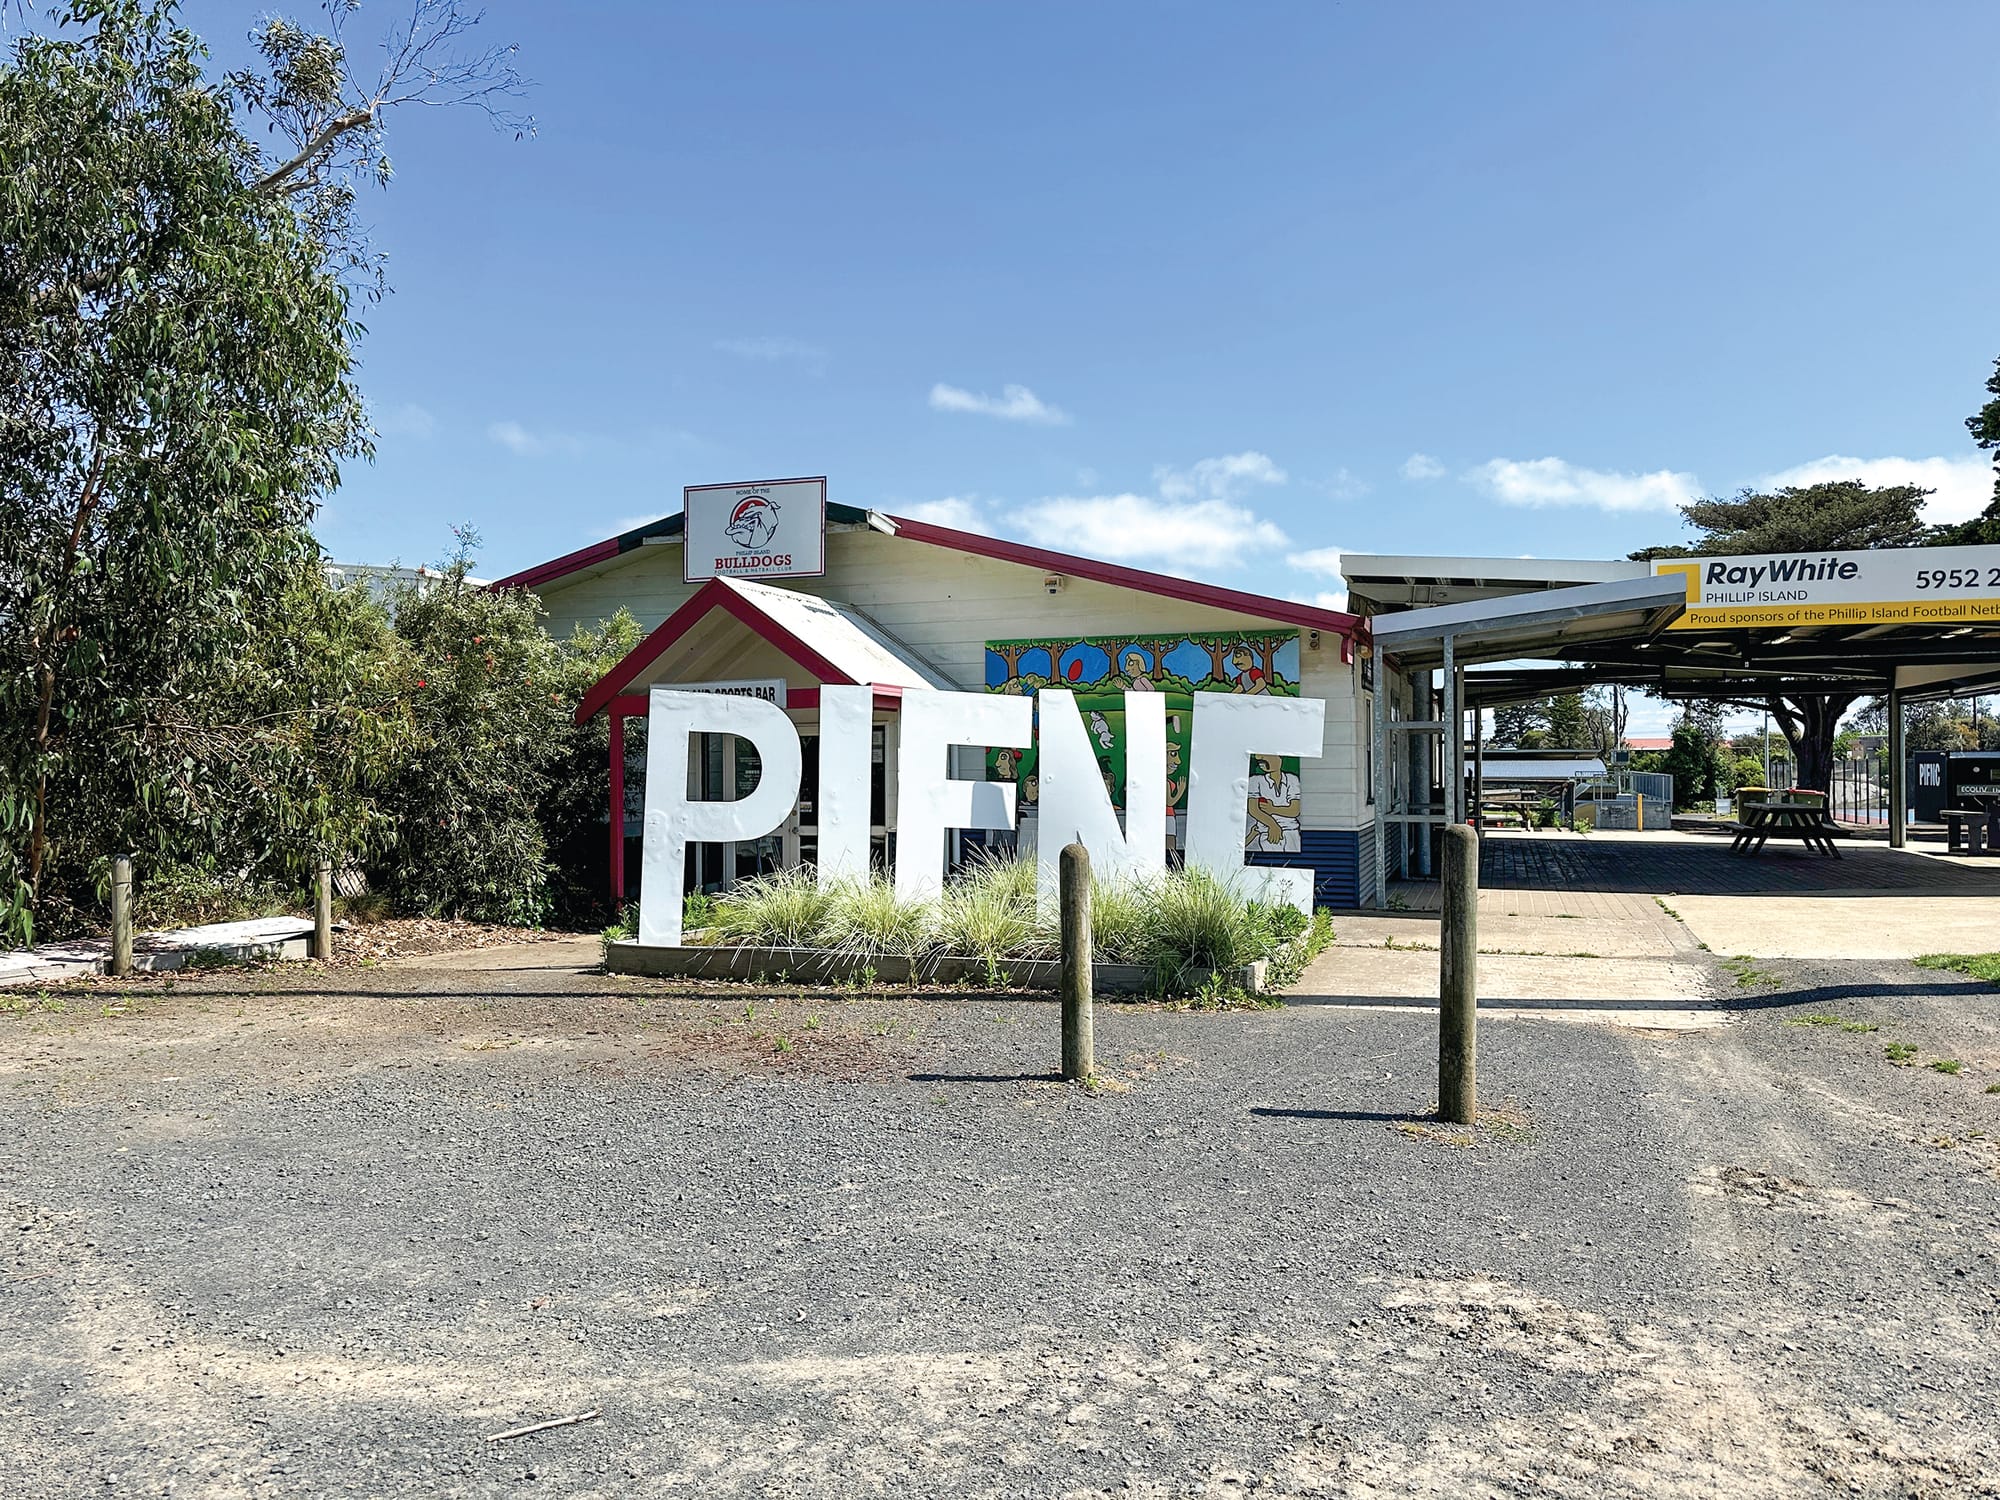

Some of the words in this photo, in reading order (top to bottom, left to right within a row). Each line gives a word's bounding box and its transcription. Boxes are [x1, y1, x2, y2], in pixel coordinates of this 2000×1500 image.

[714, 554, 792, 569] BULLDOGS
[1916, 569, 1979, 589] 5952
[1706, 592, 1755, 603] PHILLIP
[1758, 590, 1808, 602] ISLAND
[1690, 612, 1726, 623] Proud
[1730, 613, 1784, 624] sponsors
[1787, 609, 1801, 621] of
[1804, 609, 1825, 620] the
[1829, 607, 1867, 619] Phillip
[1872, 606, 1909, 618] Island
[1913, 604, 1966, 617] Football
[755, 686, 775, 701] BAR
[1919, 763, 1941, 787] PIFNC
